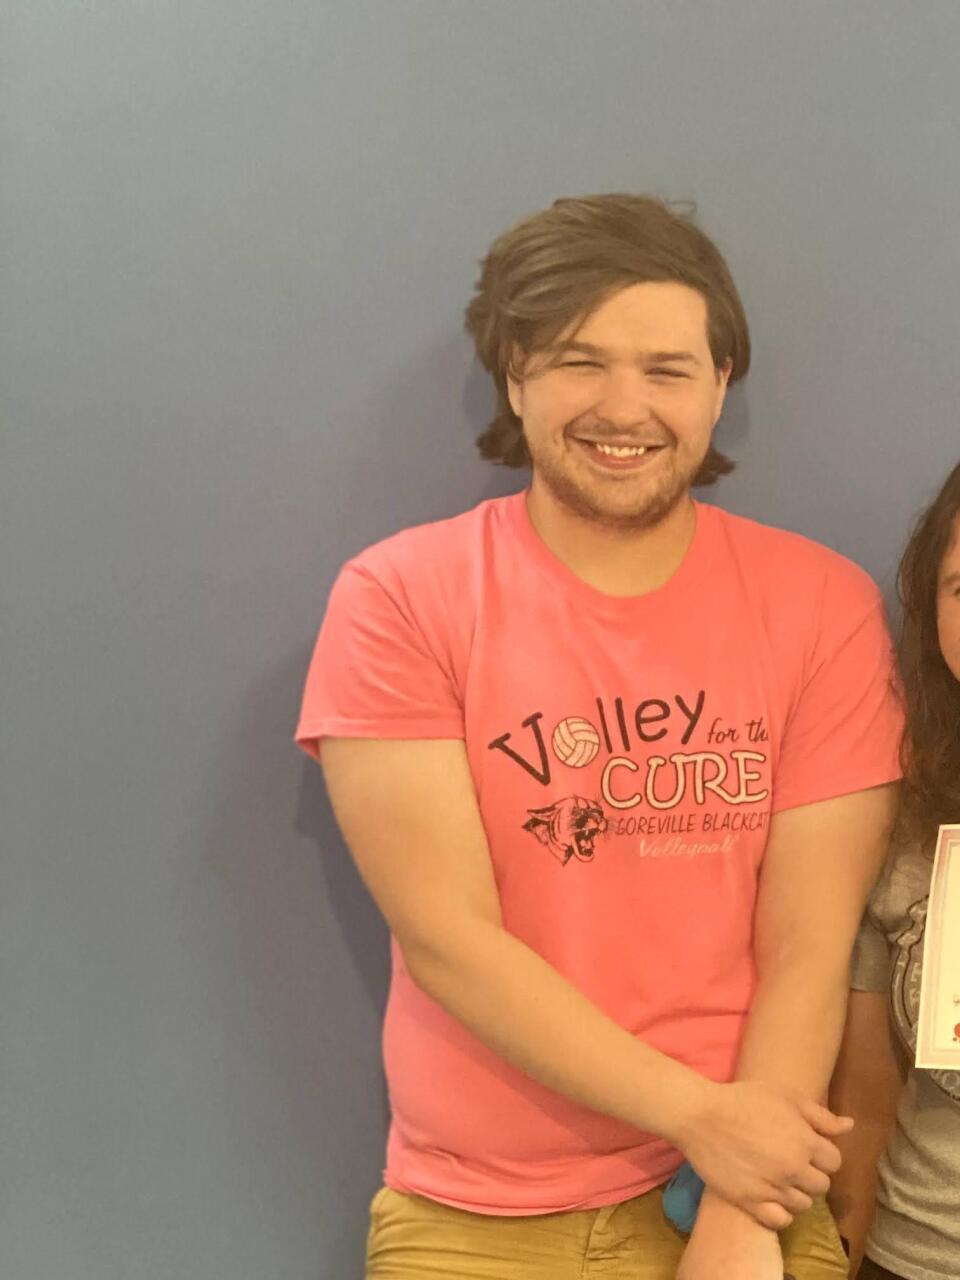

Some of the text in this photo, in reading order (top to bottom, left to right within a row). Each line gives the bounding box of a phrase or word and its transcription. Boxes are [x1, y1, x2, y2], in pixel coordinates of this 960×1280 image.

[488, 690, 768, 786] Volley for th
[601, 750, 769, 810] CURE
[614, 813, 697, 836] GOREVILLE
